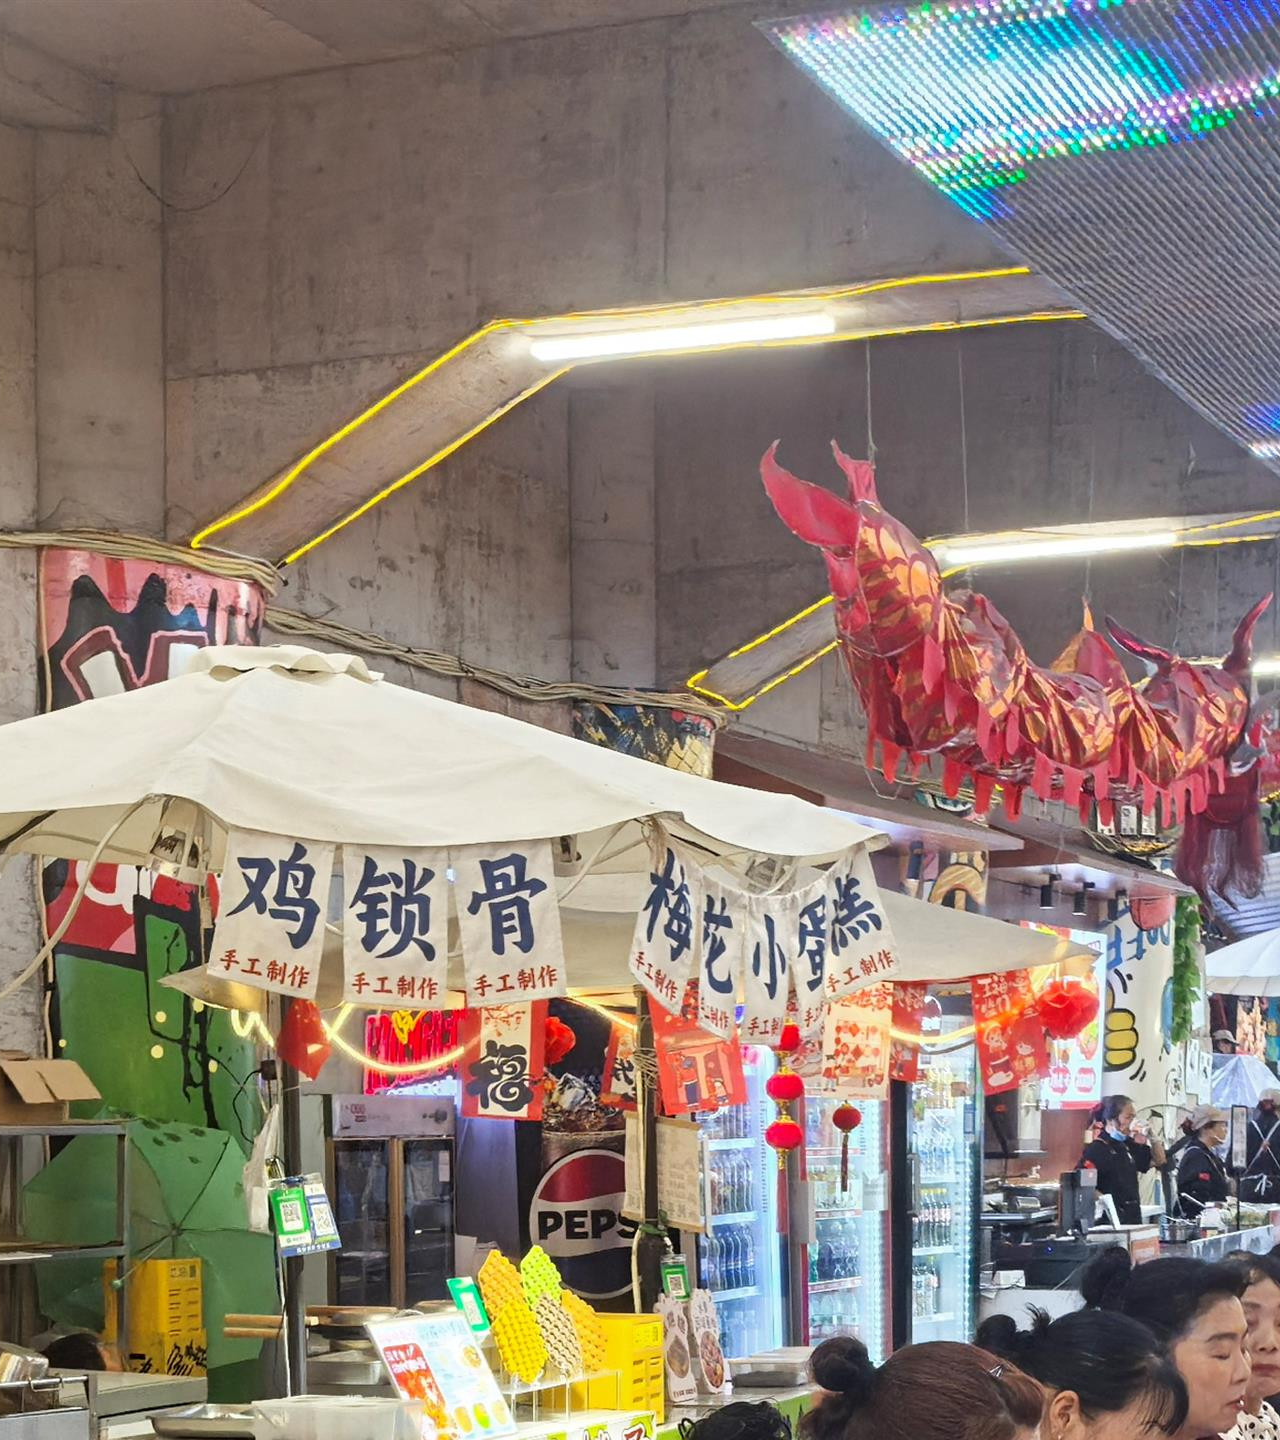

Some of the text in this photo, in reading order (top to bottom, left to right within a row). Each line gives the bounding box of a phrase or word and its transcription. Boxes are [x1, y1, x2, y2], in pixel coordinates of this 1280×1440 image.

[225, 841, 548, 962] 鸡锁骨
[220, 949, 311, 989] 手工制作
[351, 972, 439, 1000] 手工制作
[474, 965, 559, 997] 手工制作
[635, 951, 678, 1002] 手工制作
[825, 949, 895, 993] 手工制作
[538, 1209, 640, 1241] PEPS
